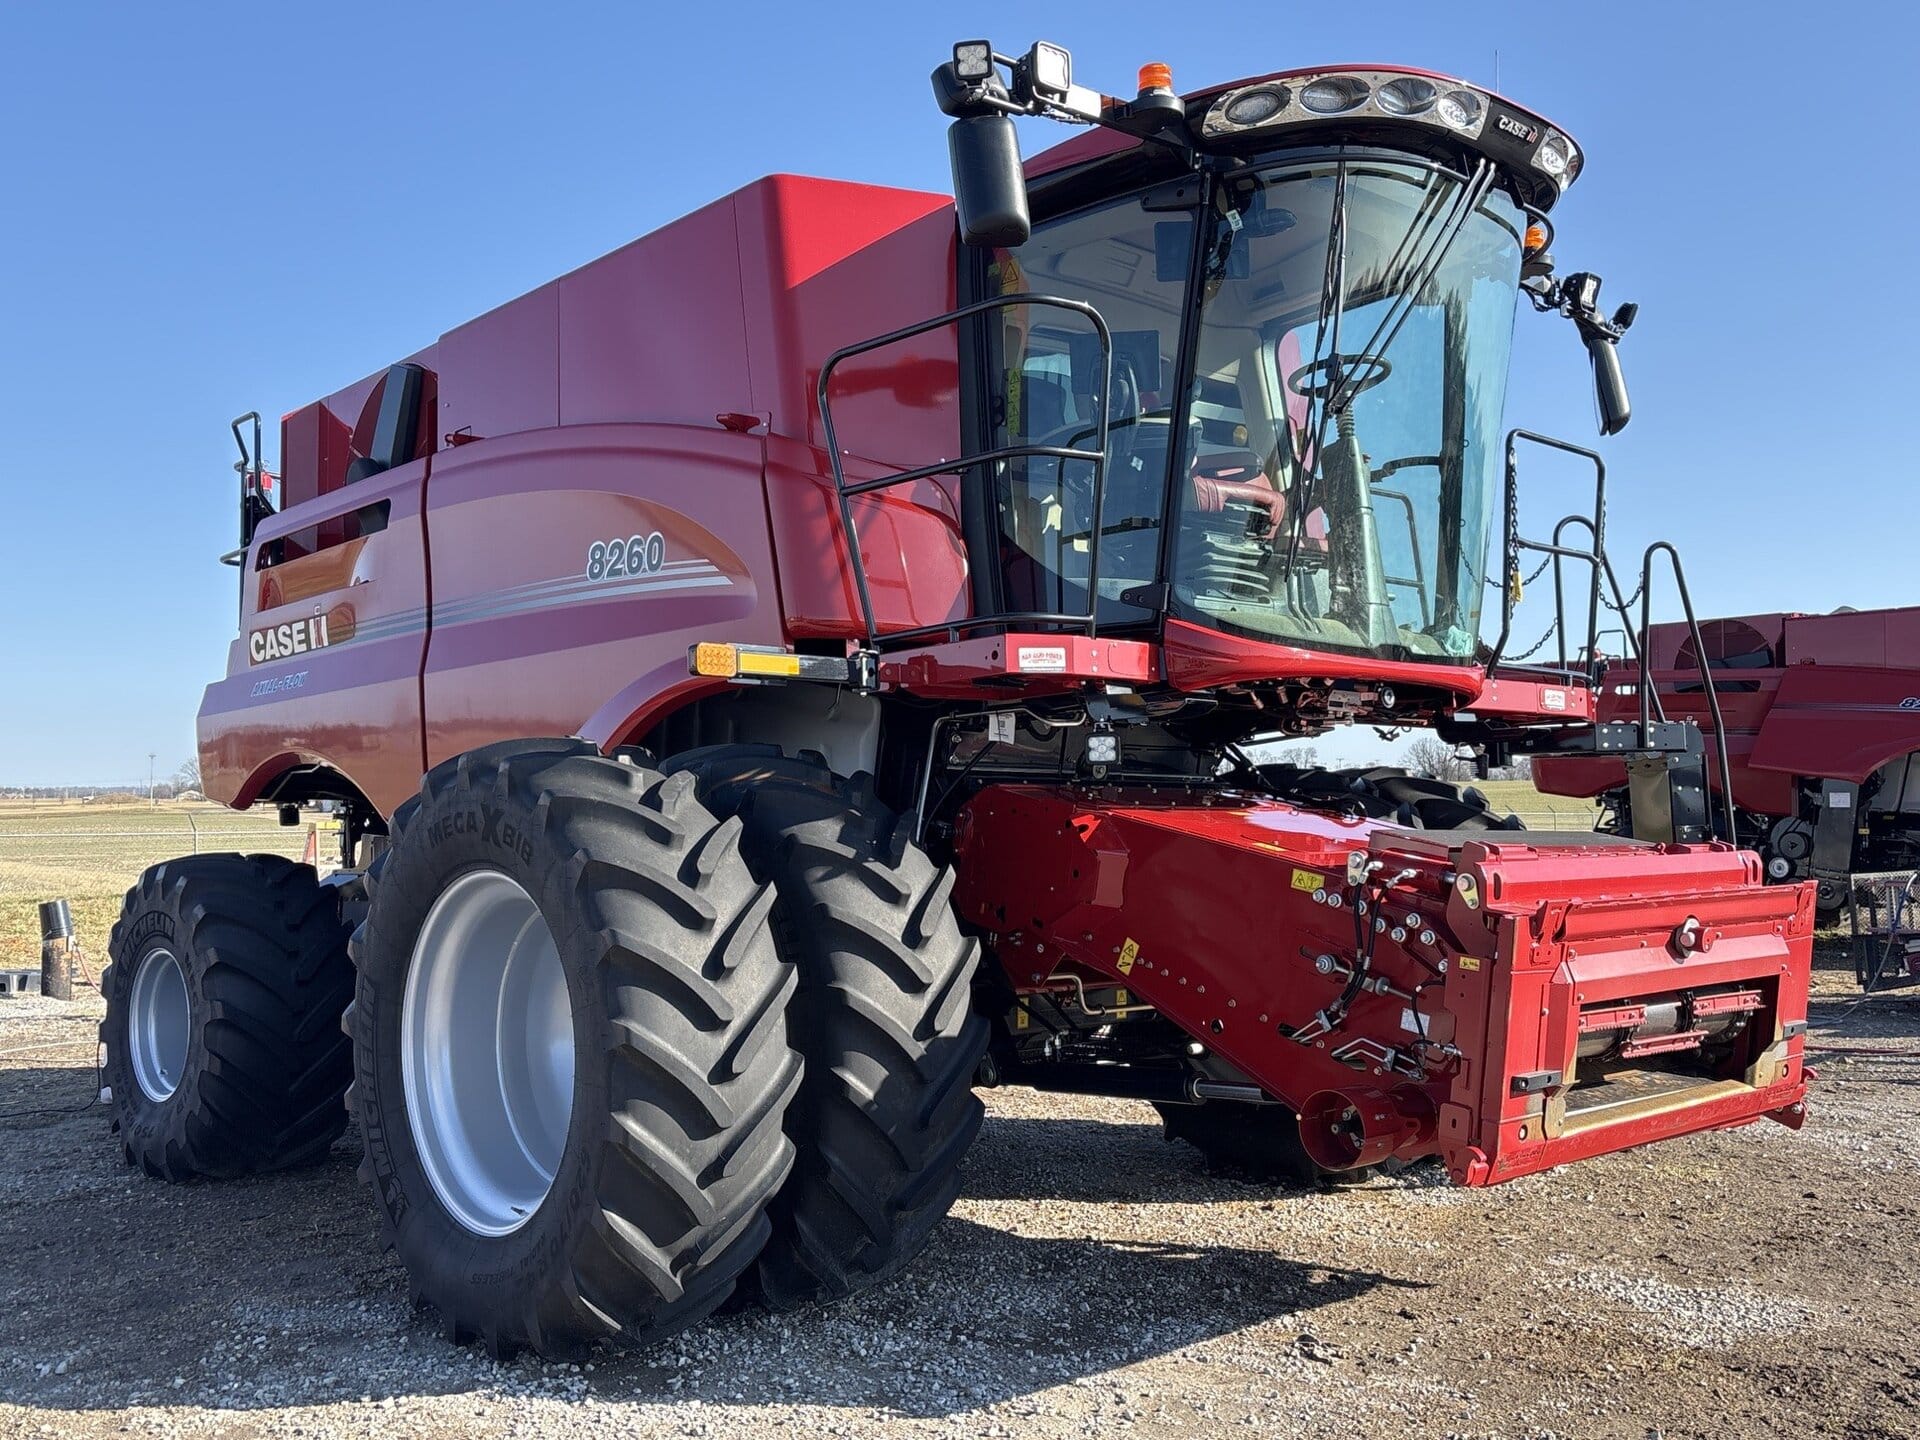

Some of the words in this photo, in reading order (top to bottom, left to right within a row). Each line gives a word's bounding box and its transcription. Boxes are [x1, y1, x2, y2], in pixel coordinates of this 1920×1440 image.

[1498, 115, 1527, 138] CASE
[587, 530, 666, 582] 8260
[250, 620, 307, 662] CASE
